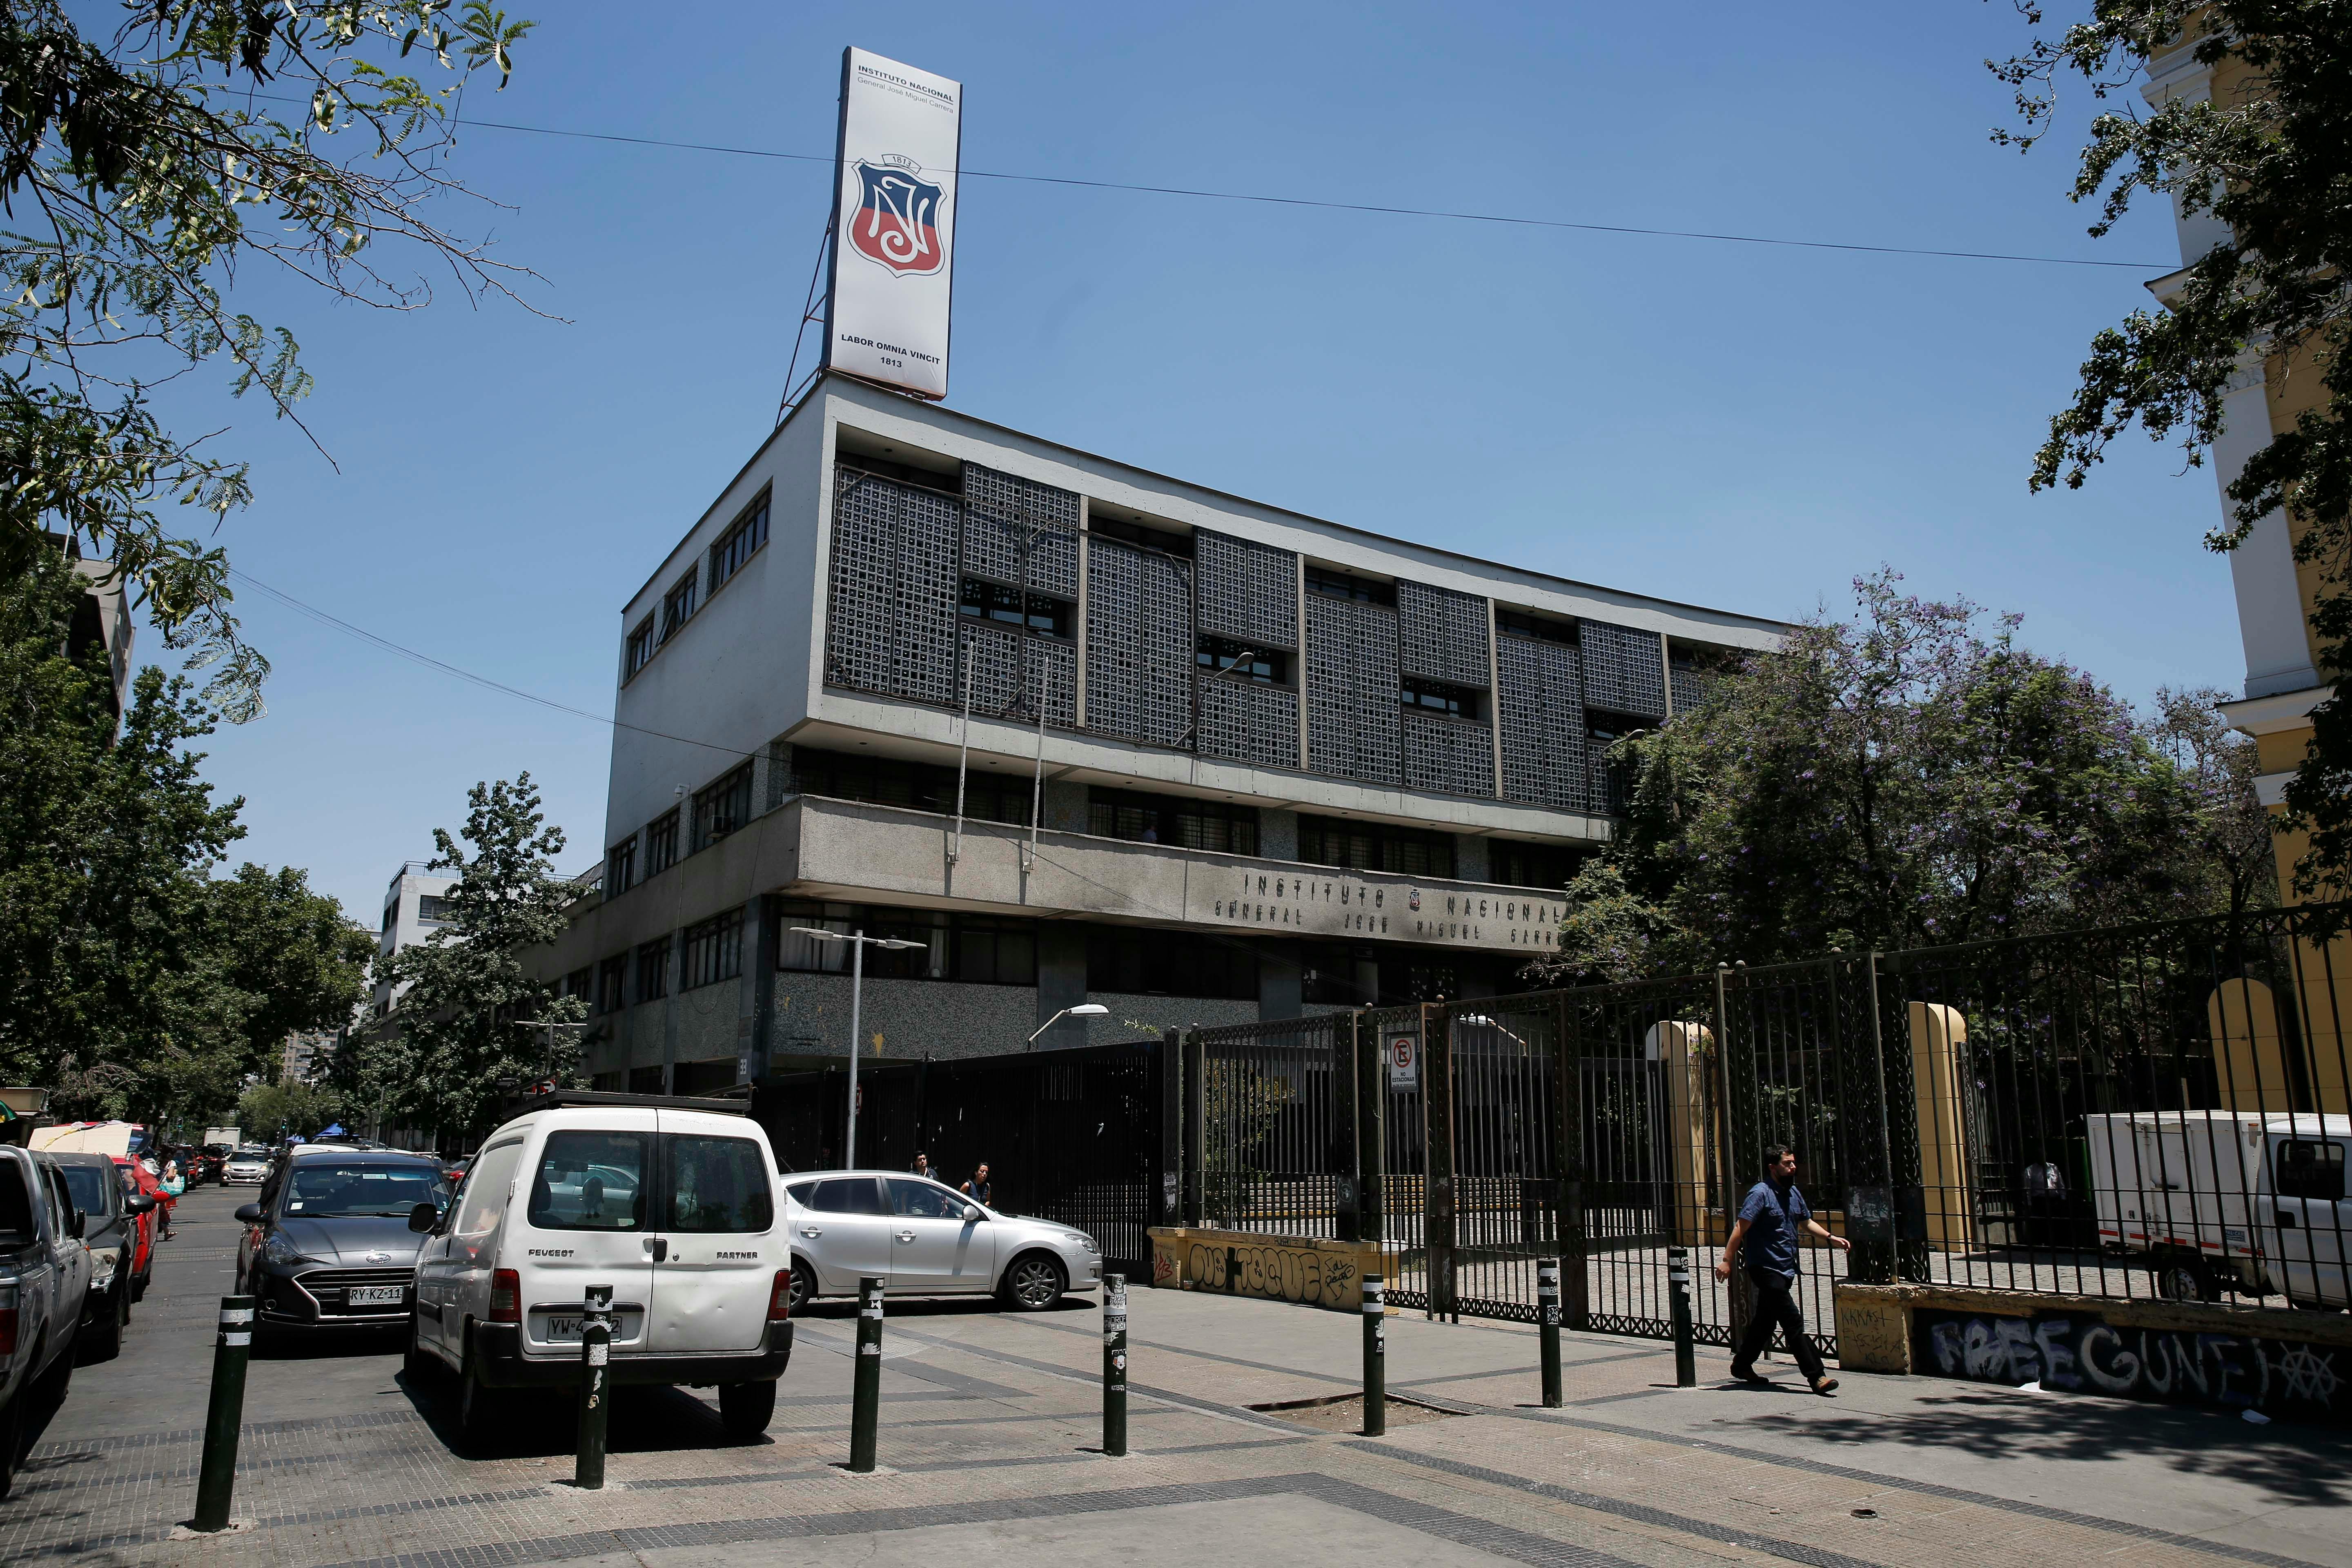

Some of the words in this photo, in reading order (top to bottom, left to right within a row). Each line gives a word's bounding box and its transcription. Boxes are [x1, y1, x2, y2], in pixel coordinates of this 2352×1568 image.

[858, 65, 907, 85] INSTITUTO
[909, 81, 953, 102] NACIONAL
[858, 77, 885, 89] General
[887, 86, 904, 95] José
[905, 91, 927, 104] Miguel
[929, 100, 953, 114] Carrera
[892, 156, 911, 167] 1813
[841, 334, 873, 347] LABOR
[877, 342, 907, 355] OMNIA
[910, 350, 940, 364] VINCIT
[880, 357, 902, 368] 1813
[1245, 874, 1383, 907] INSTITUTO
[1448, 897, 1559, 923] NACIONAL
[1215, 900, 1301, 924] GENERAL
[1345, 914, 1388, 933] JOSE
[1417, 920, 1479, 939] MIGUEL
[740, 1059, 747, 1075] 33
[528, 1249, 575, 1258] PEUGEOT
